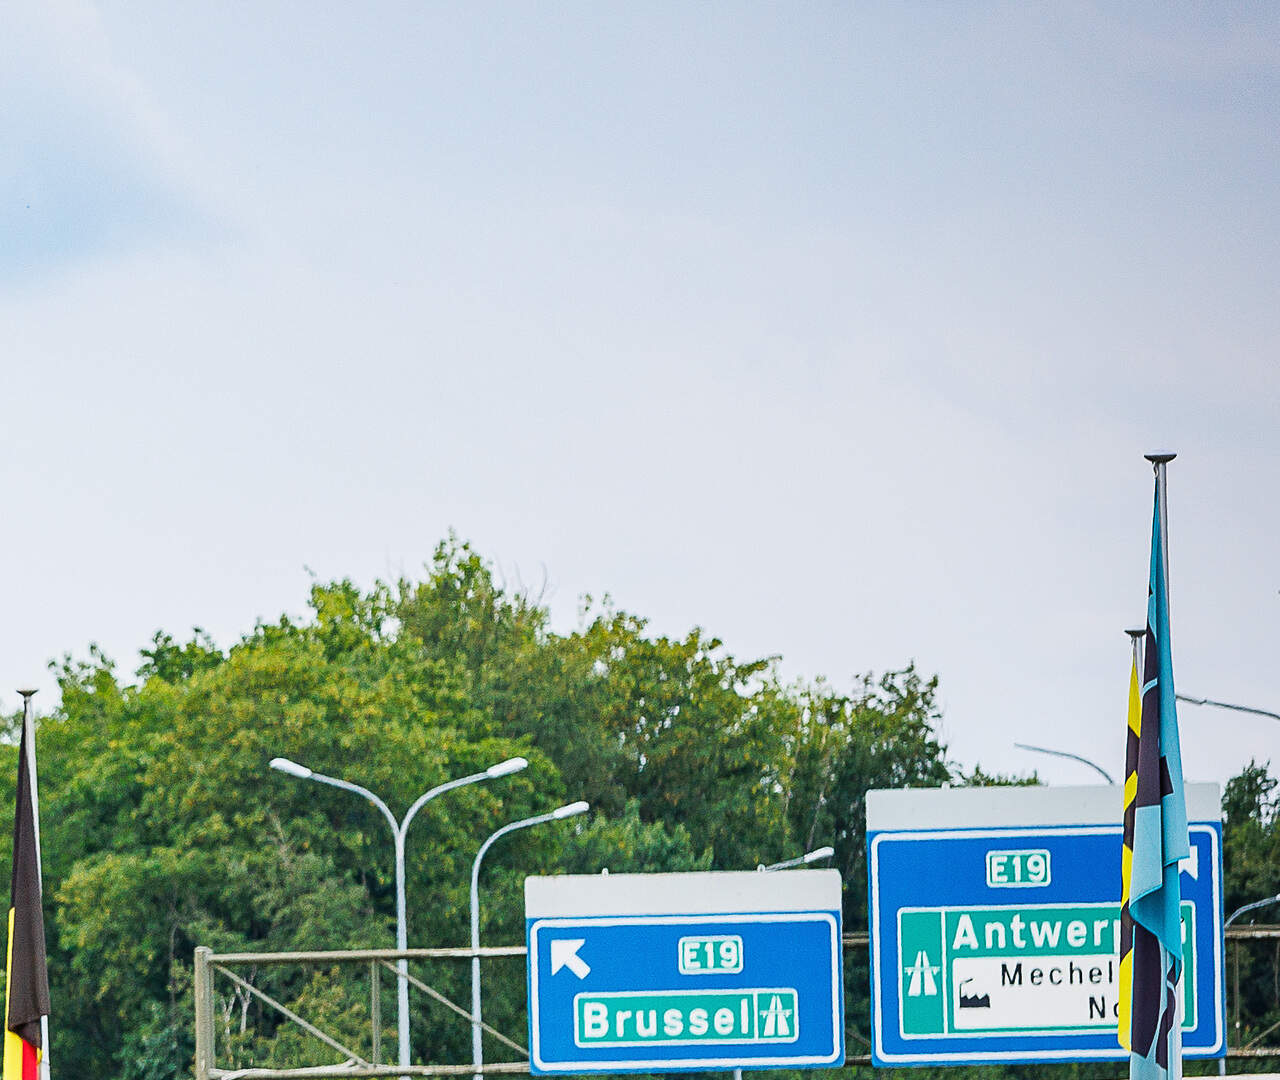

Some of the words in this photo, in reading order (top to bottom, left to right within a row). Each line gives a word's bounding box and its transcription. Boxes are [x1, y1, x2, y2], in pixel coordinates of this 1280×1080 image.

[991, 855, 1045, 882] E19
[952, 913, 1186, 953] Antwer
[684, 942, 738, 969] E19
[1001, 961, 1113, 987] Mechel
[583, 998, 749, 1038] Brussel
